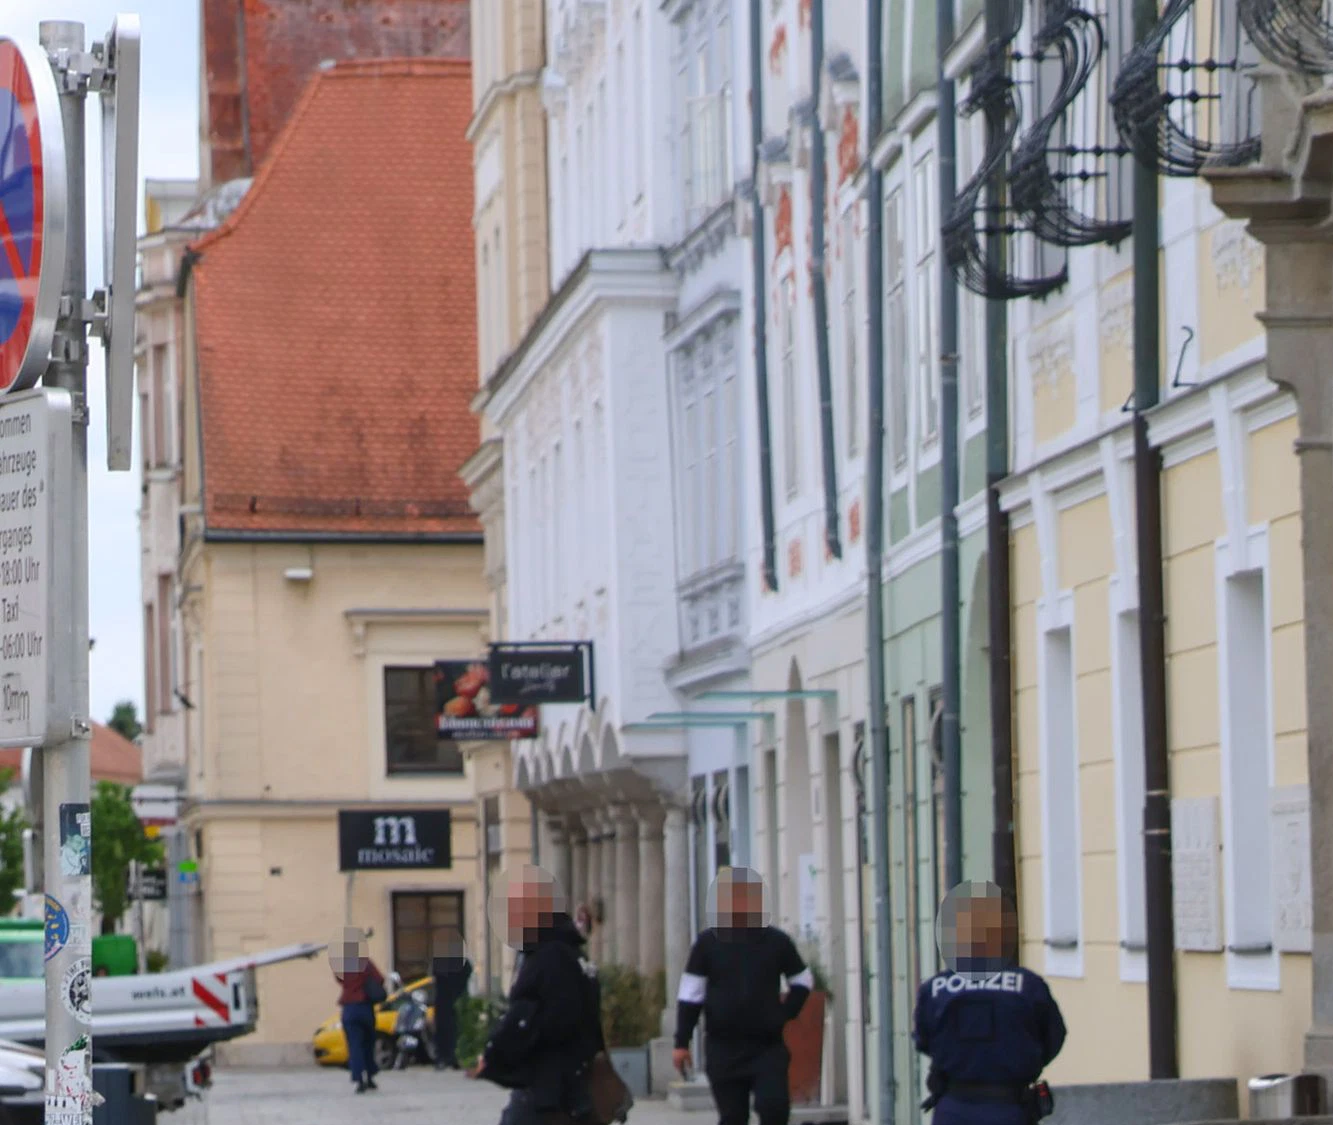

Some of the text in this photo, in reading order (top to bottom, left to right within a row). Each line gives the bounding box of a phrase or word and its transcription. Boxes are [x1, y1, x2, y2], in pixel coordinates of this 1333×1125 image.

[0, 413, 31, 438] ommen
[25, 556, 40, 583] Uhr
[2, 594, 19, 623] Taxi
[27, 631, 42, 657] Uhr
[932, 972, 1023, 997] POLIZEI
